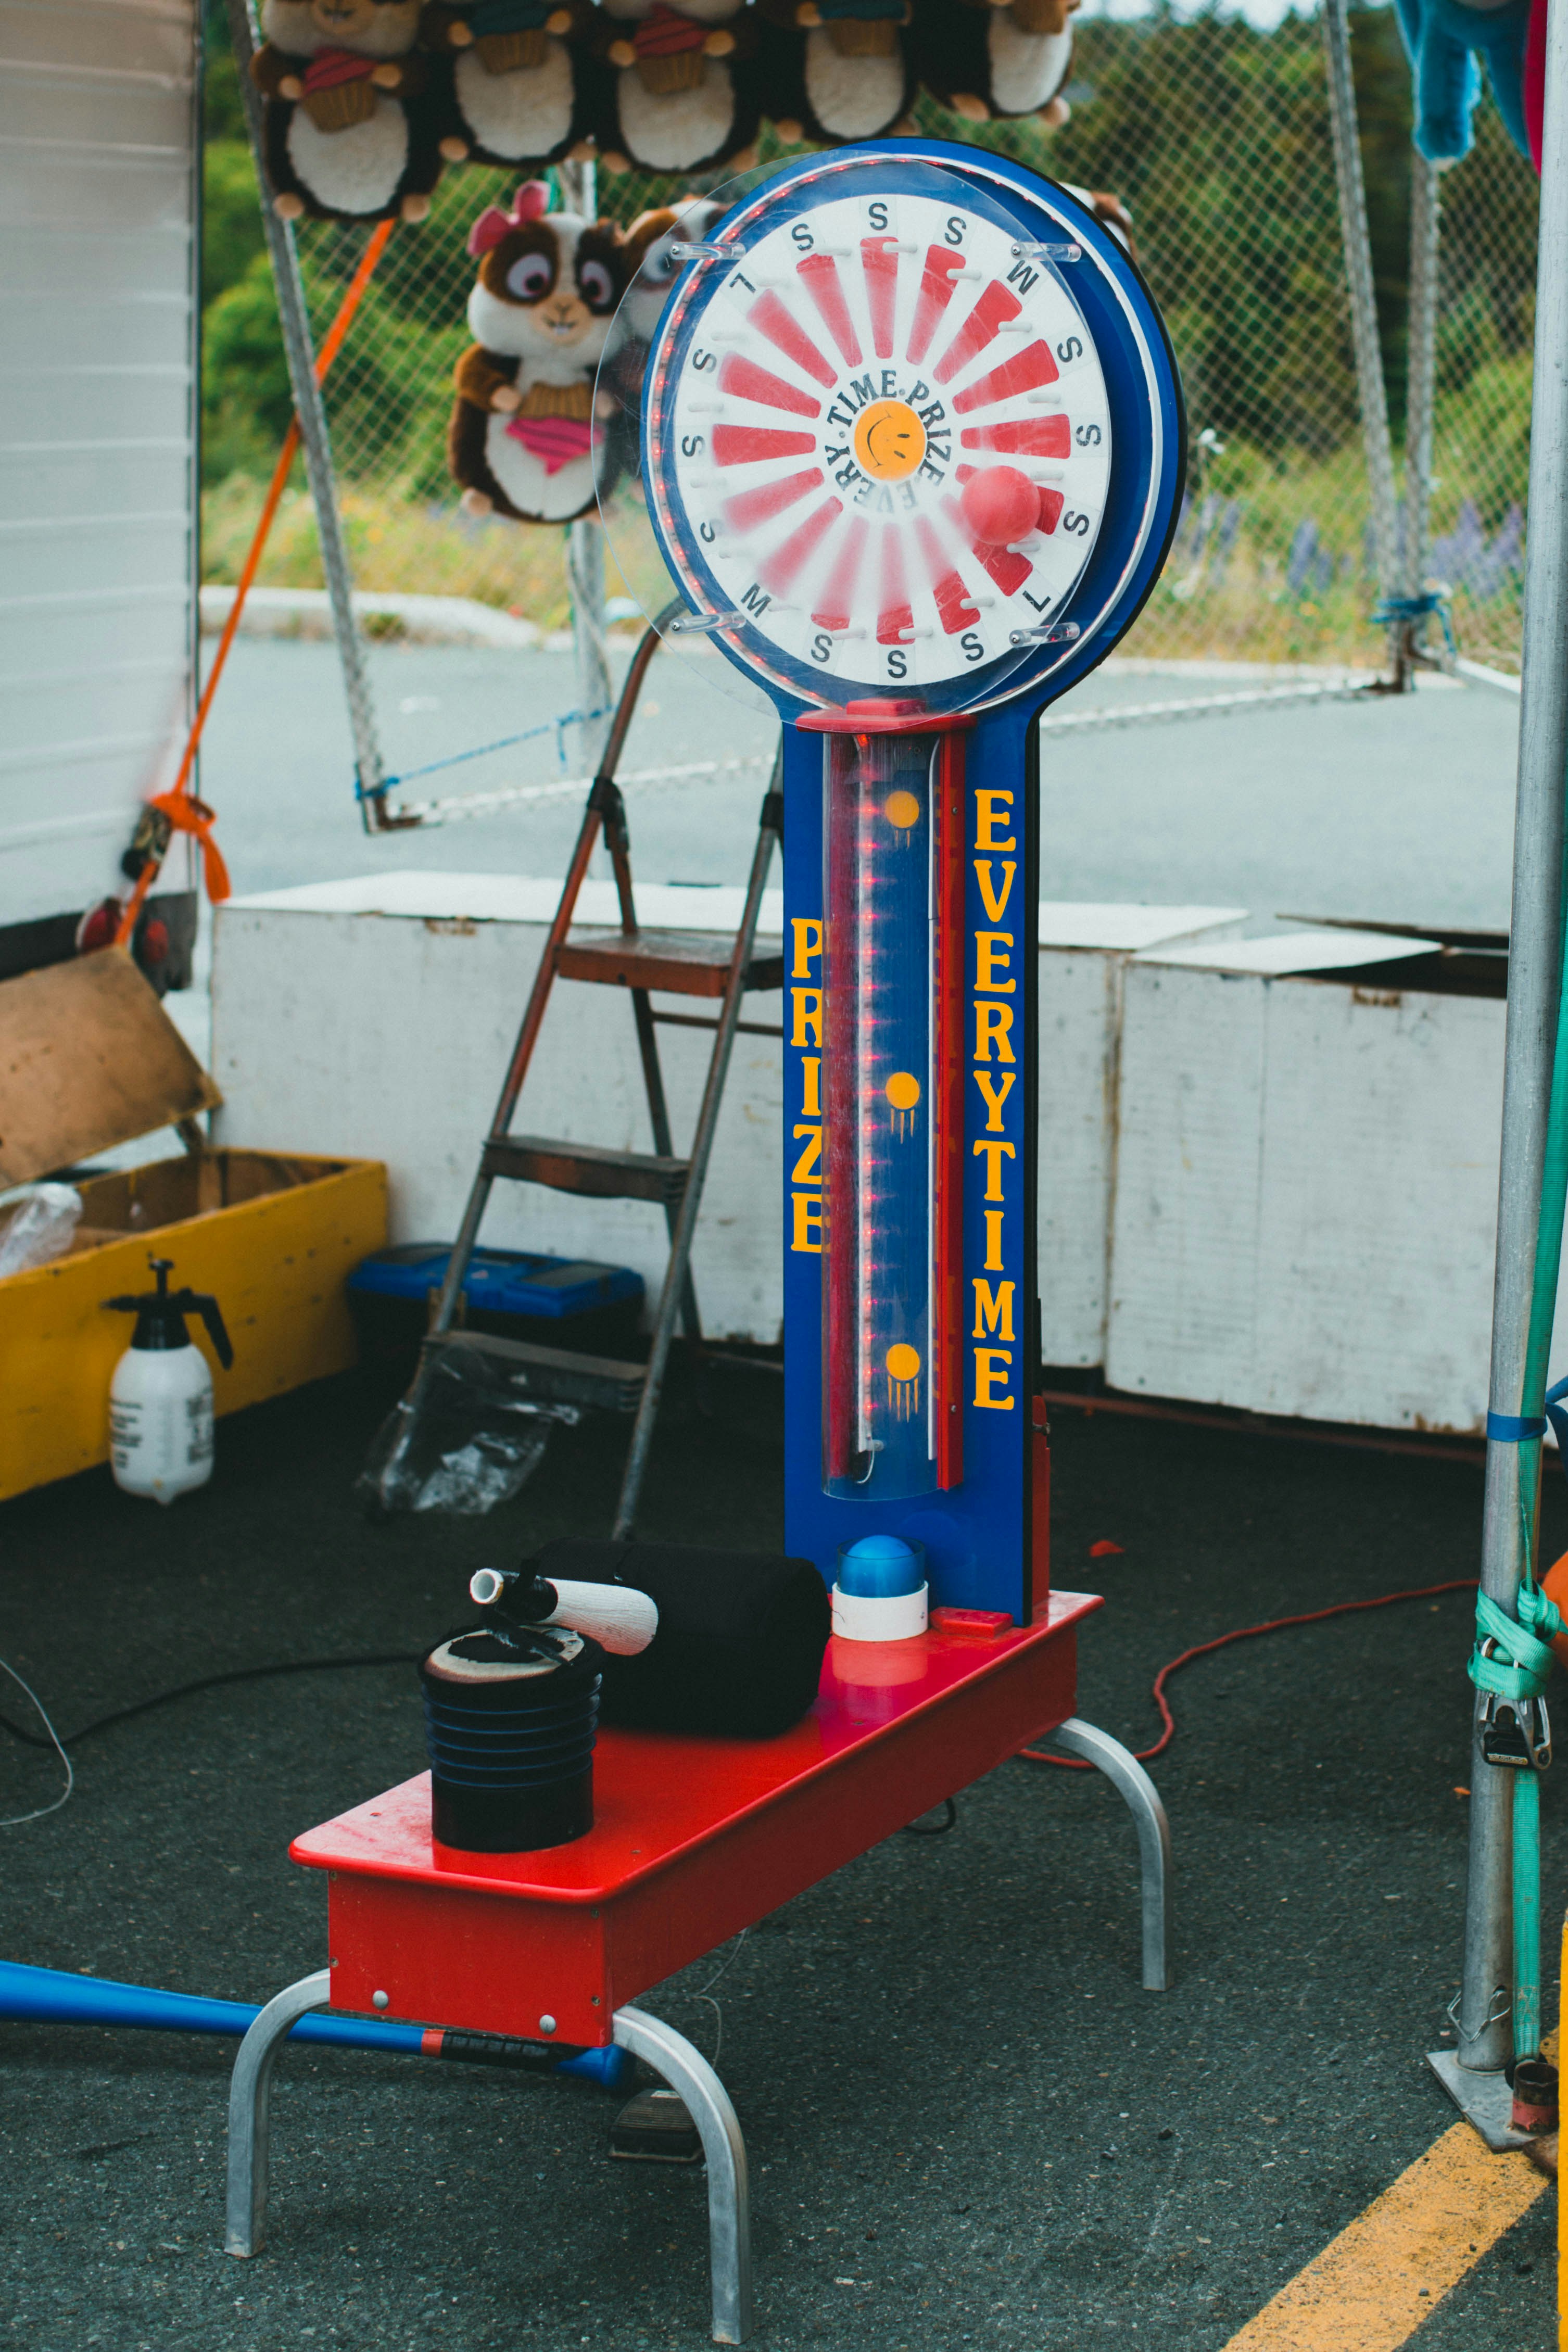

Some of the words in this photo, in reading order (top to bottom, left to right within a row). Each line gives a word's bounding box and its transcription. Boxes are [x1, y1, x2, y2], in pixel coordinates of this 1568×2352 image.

[869, 203, 888, 231] S
[944, 217, 966, 246] S
[792, 224, 814, 251] S
[1007, 260, 1039, 295] M
[1057, 336, 1083, 363] S
[827, 370, 896, 427] TIME
[905, 380, 952, 487] PRIZE
[1076, 424, 1101, 447] S
[825, 445, 918, 514] EVERY
[1063, 510, 1090, 536] S
[741, 583, 771, 618] M
[811, 634, 832, 663] S
[960, 632, 984, 662] S
[888, 650, 907, 679] S
[791, 918, 825, 1253] PRIZE
[972, 789, 1017, 1410] EVERYTIME
